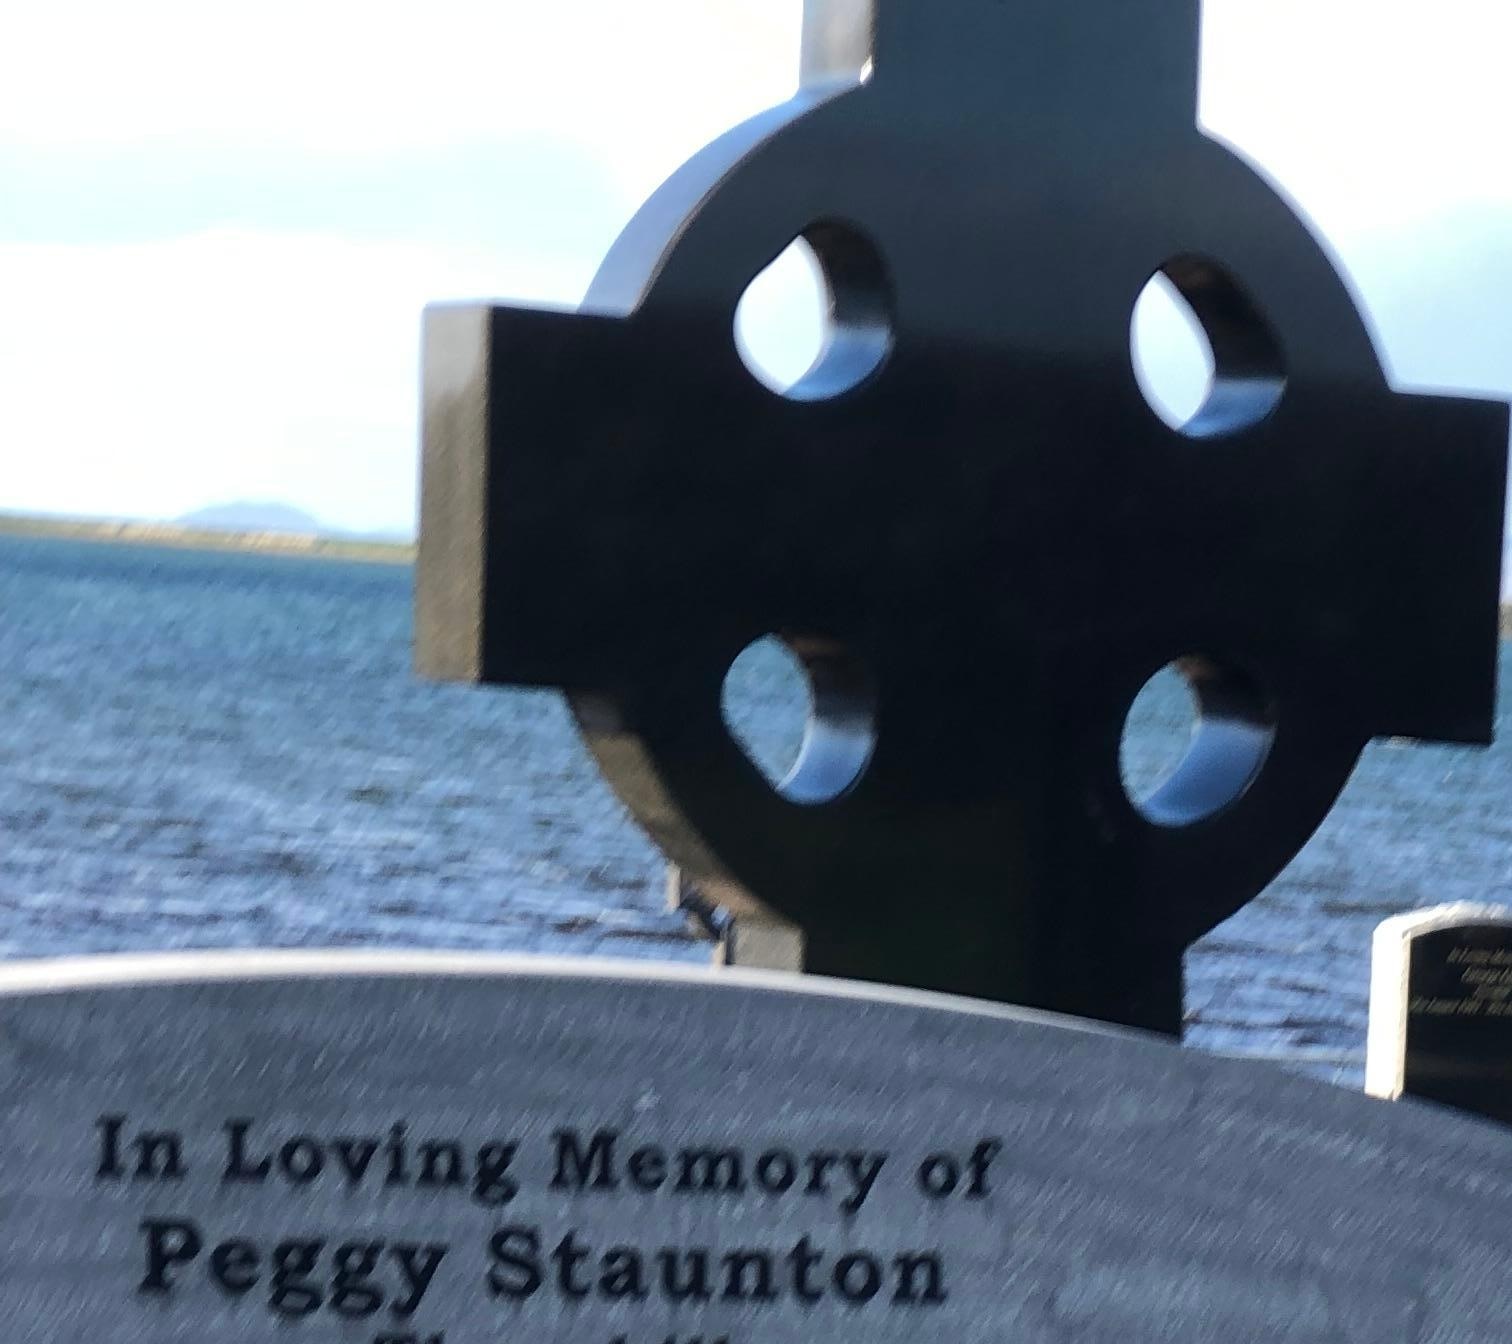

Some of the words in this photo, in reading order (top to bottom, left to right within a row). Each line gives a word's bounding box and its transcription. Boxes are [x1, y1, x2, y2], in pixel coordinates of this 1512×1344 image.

[95, 1115, 188, 1184] In
[221, 1116, 518, 1208] Loving
[549, 1127, 889, 1217] Memory
[917, 1138, 1003, 1202] of
[138, 1217, 449, 1326] Peggy
[486, 1224, 948, 1307] Staunton
